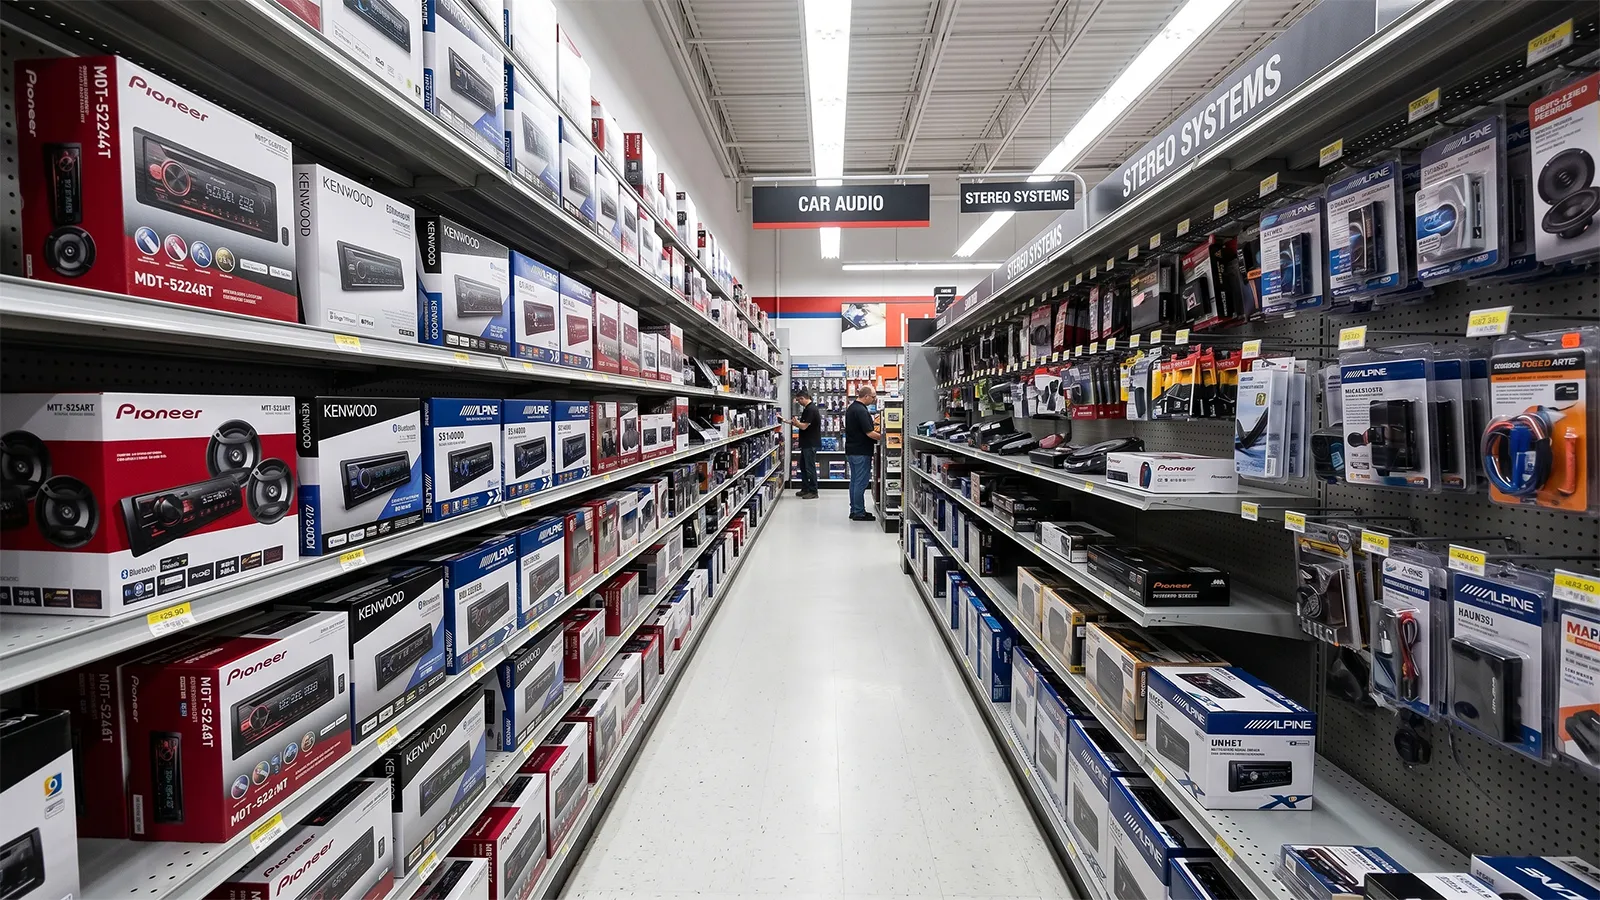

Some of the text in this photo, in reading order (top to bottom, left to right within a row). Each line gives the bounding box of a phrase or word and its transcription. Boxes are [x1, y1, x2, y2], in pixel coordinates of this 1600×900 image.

[25, 68, 37, 138] Pioneer
[128, 75, 209, 122] Pioneer
[1122, 53, 1282, 198] STEREO SYSTEMS
[1507, 127, 1529, 143] PINE
[298, 172, 311, 237] KENWOOD
[322, 175, 374, 209] KENWOOD
[798, 194, 884, 212] CAR AUDIO
[965, 188, 1070, 205] STEREO SYSTEMS
[427, 220, 436, 266] KENWOOD
[443, 224, 480, 250] KENWOOD
[1006, 223, 1063, 280] STEREO SYSTEMS
[430, 300, 438, 340] KENWOOD
[115, 402, 203, 420] Pioneer
[302, 403, 310, 449] KENWOOD
[323, 403, 378, 418] KENWOOD
[1157, 464, 1196, 473] Pioneer
[129, 564, 157, 577] Bluetooth
[1153, 582, 1192, 590] Pioneer
[358, 590, 405, 621] KENWOOD
[226, 650, 288, 687] Pioneer
[131, 675, 139, 723] Pioneer
[405, 723, 448, 766] KENWOOD
[1211, 739, 1243, 747] UNHET
[263, 833, 317, 878] Pioneer
[276, 838, 335, 897] Pioneer
